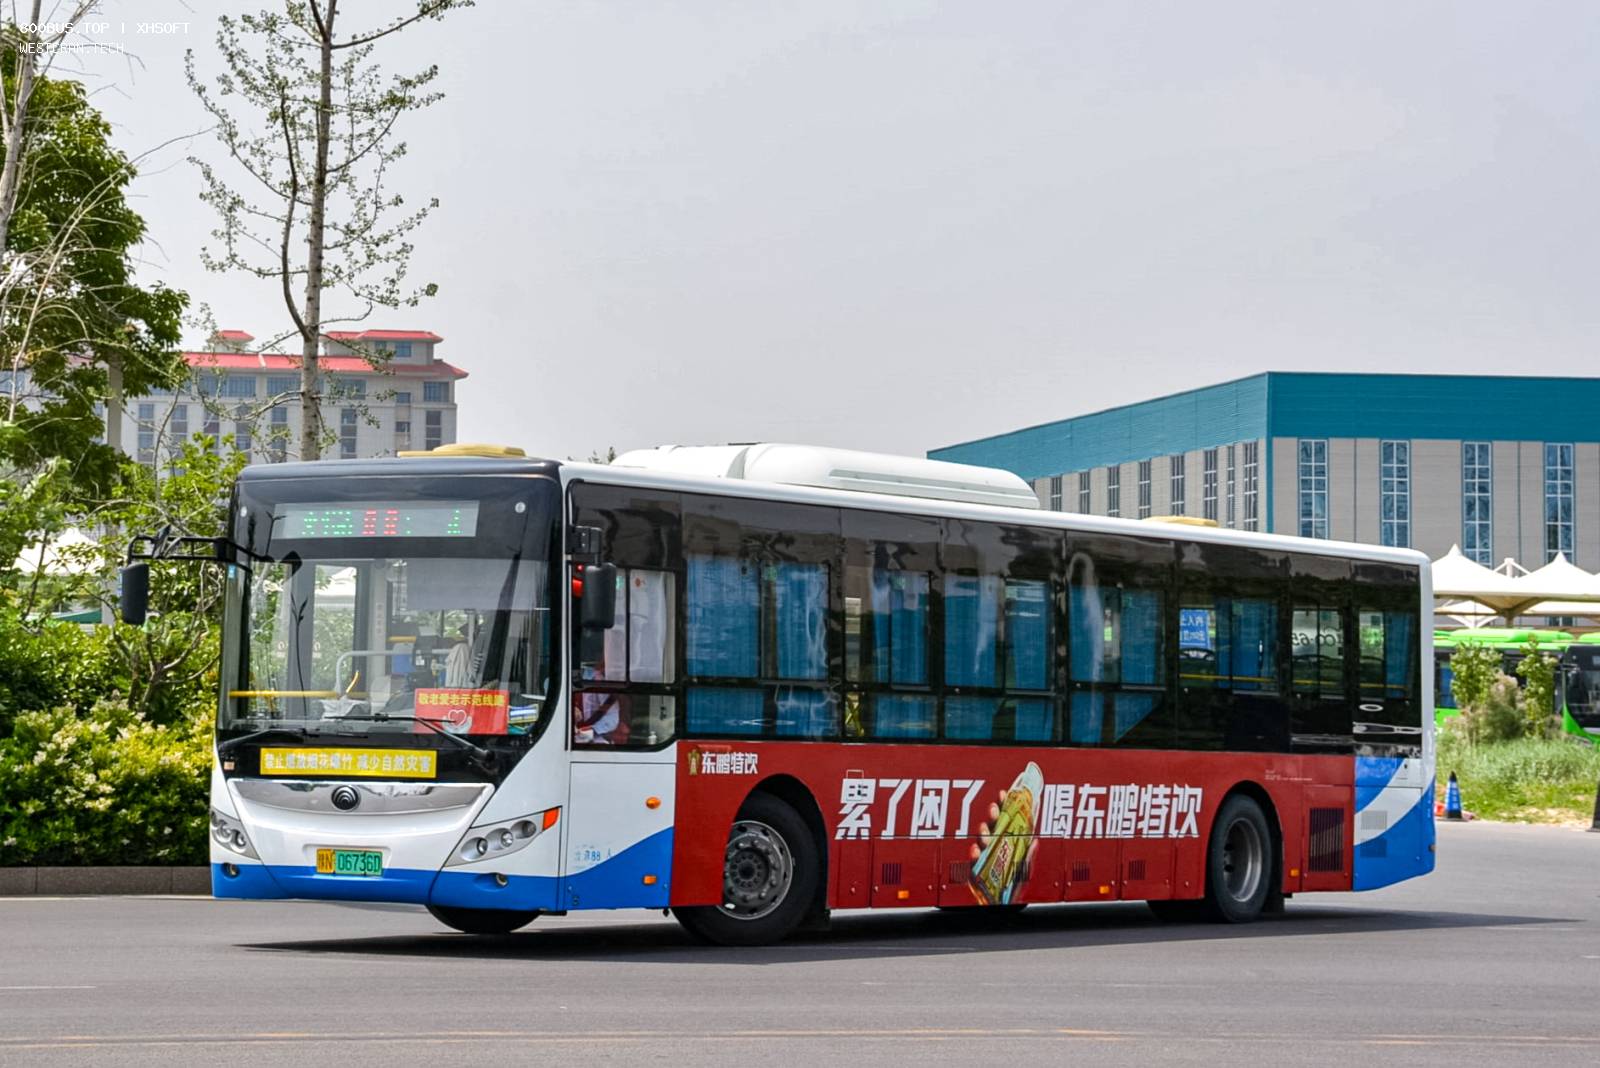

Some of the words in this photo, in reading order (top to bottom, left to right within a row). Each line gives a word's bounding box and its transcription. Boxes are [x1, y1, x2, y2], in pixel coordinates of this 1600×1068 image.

[701, 752, 759, 775] 东鹏特饮
[834, 778, 986, 840] 累了困了
[1039, 783, 1203, 839] 喝东鹏特饮
